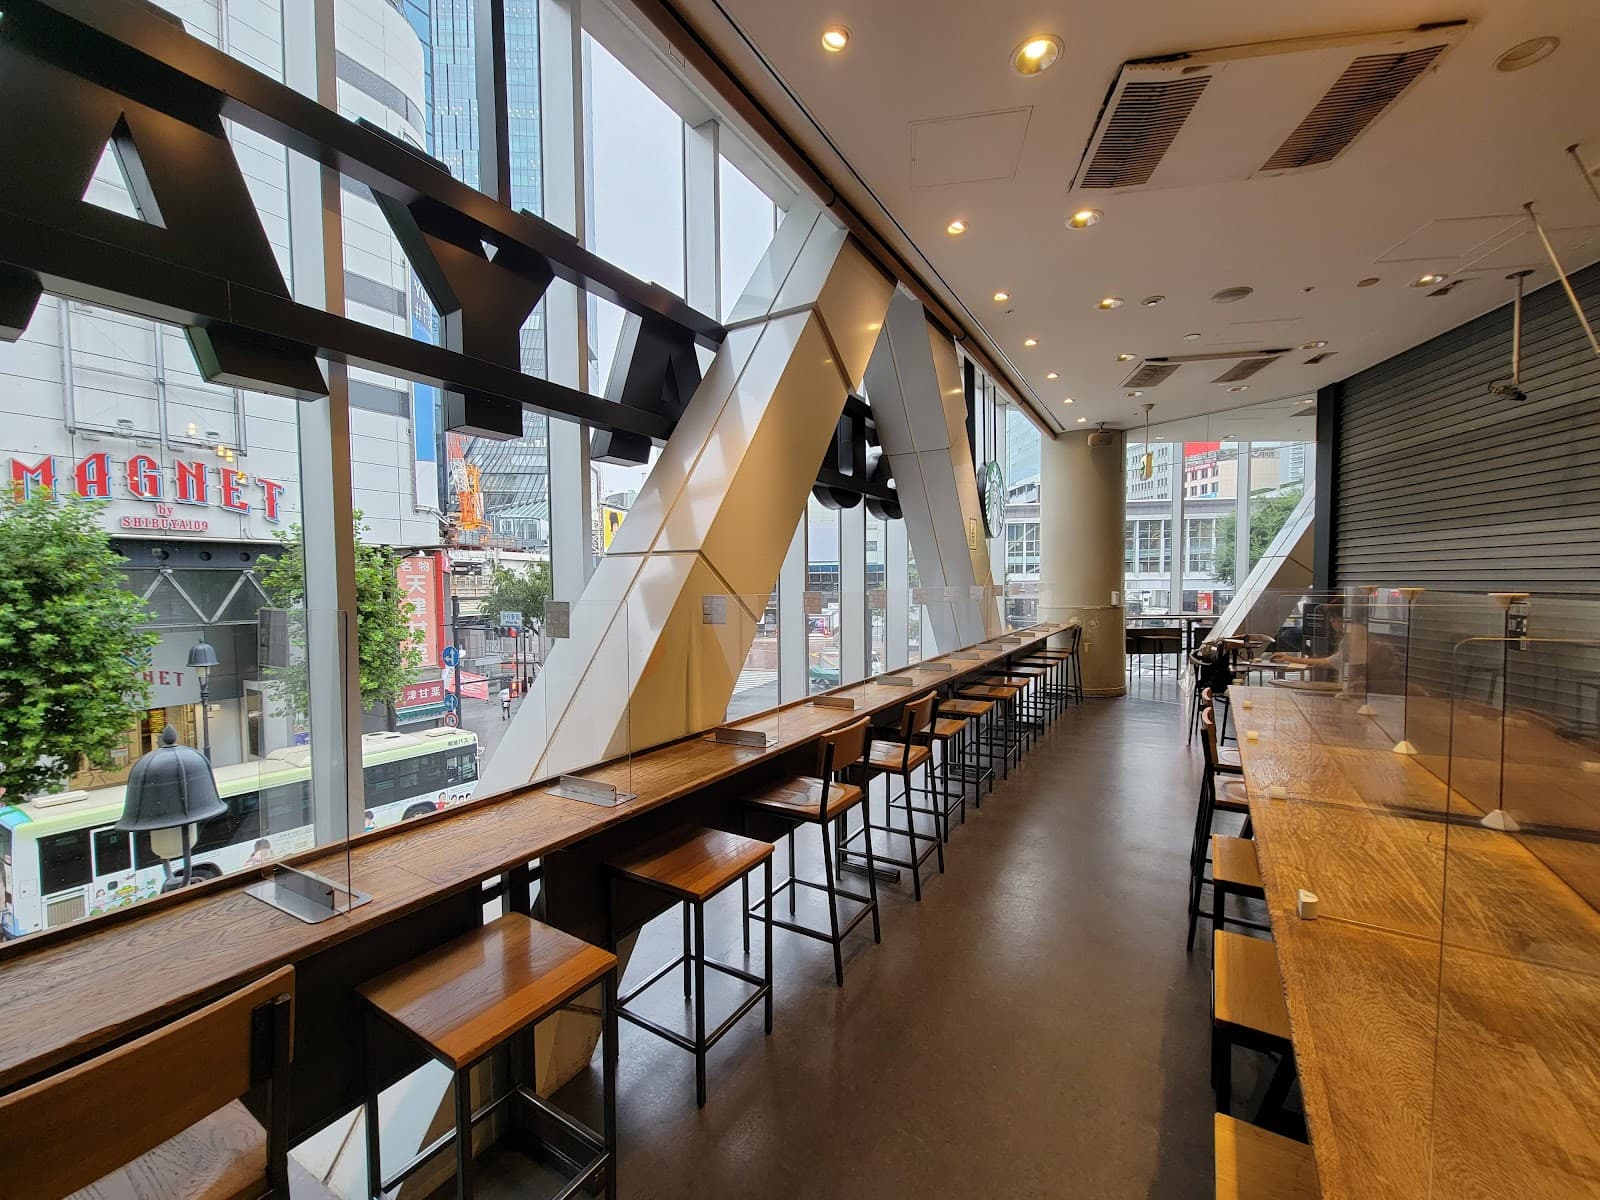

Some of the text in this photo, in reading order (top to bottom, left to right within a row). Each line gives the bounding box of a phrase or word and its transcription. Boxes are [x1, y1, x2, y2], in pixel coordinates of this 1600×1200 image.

[9, 452, 284, 524] MAGNET
[157, 503, 173, 516] by
[122, 516, 208, 531] SHIBUYA109
[136, 669, 184, 687] NET
[403, 686, 441, 701] 津甘栗
